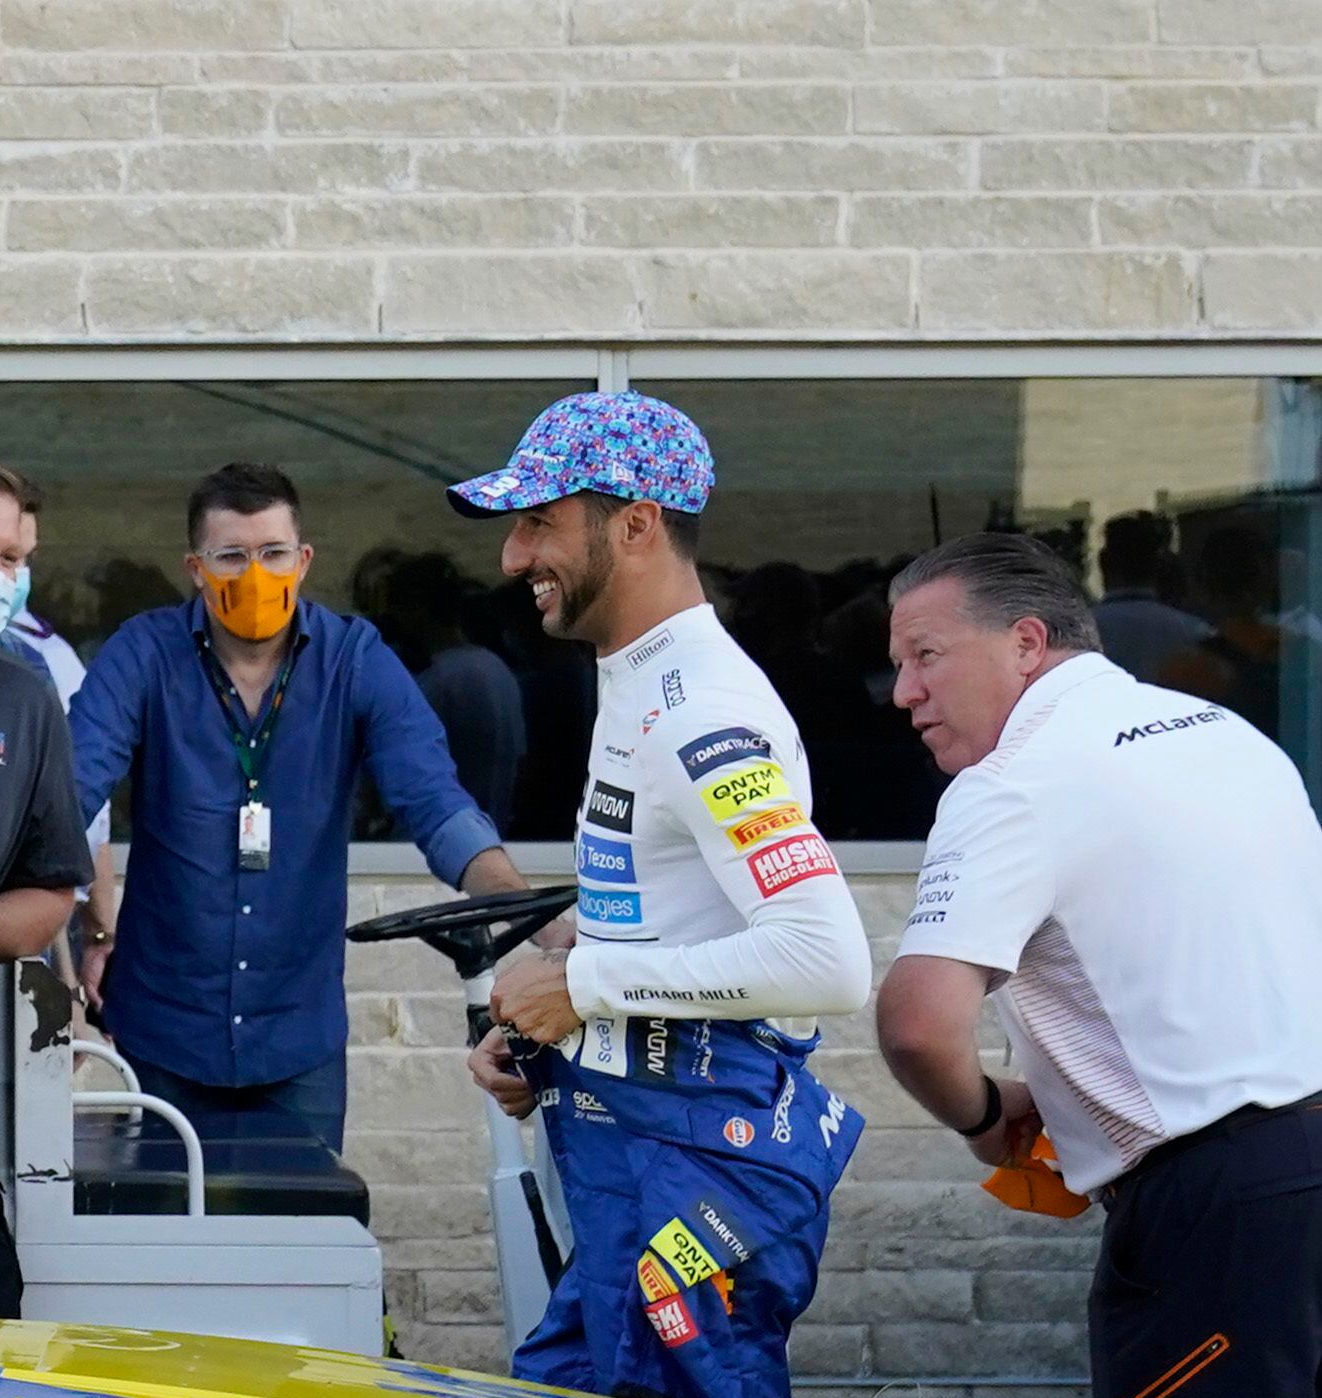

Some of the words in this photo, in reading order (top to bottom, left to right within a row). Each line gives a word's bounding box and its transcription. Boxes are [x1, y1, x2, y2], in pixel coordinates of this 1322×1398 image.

[630, 636, 670, 666] Hilton
[1114, 712, 1226, 747] McLaren
[695, 737, 767, 763] DARKTRACE
[712, 768, 775, 800] QNTM
[732, 782, 772, 806] PAY
[587, 846, 626, 871] Tezos
[753, 837, 830, 880] HUSKI
[763, 856, 834, 890] CHOCOLATE
[623, 988, 694, 1001] RICHARD
[700, 987, 751, 1001] MILLE
